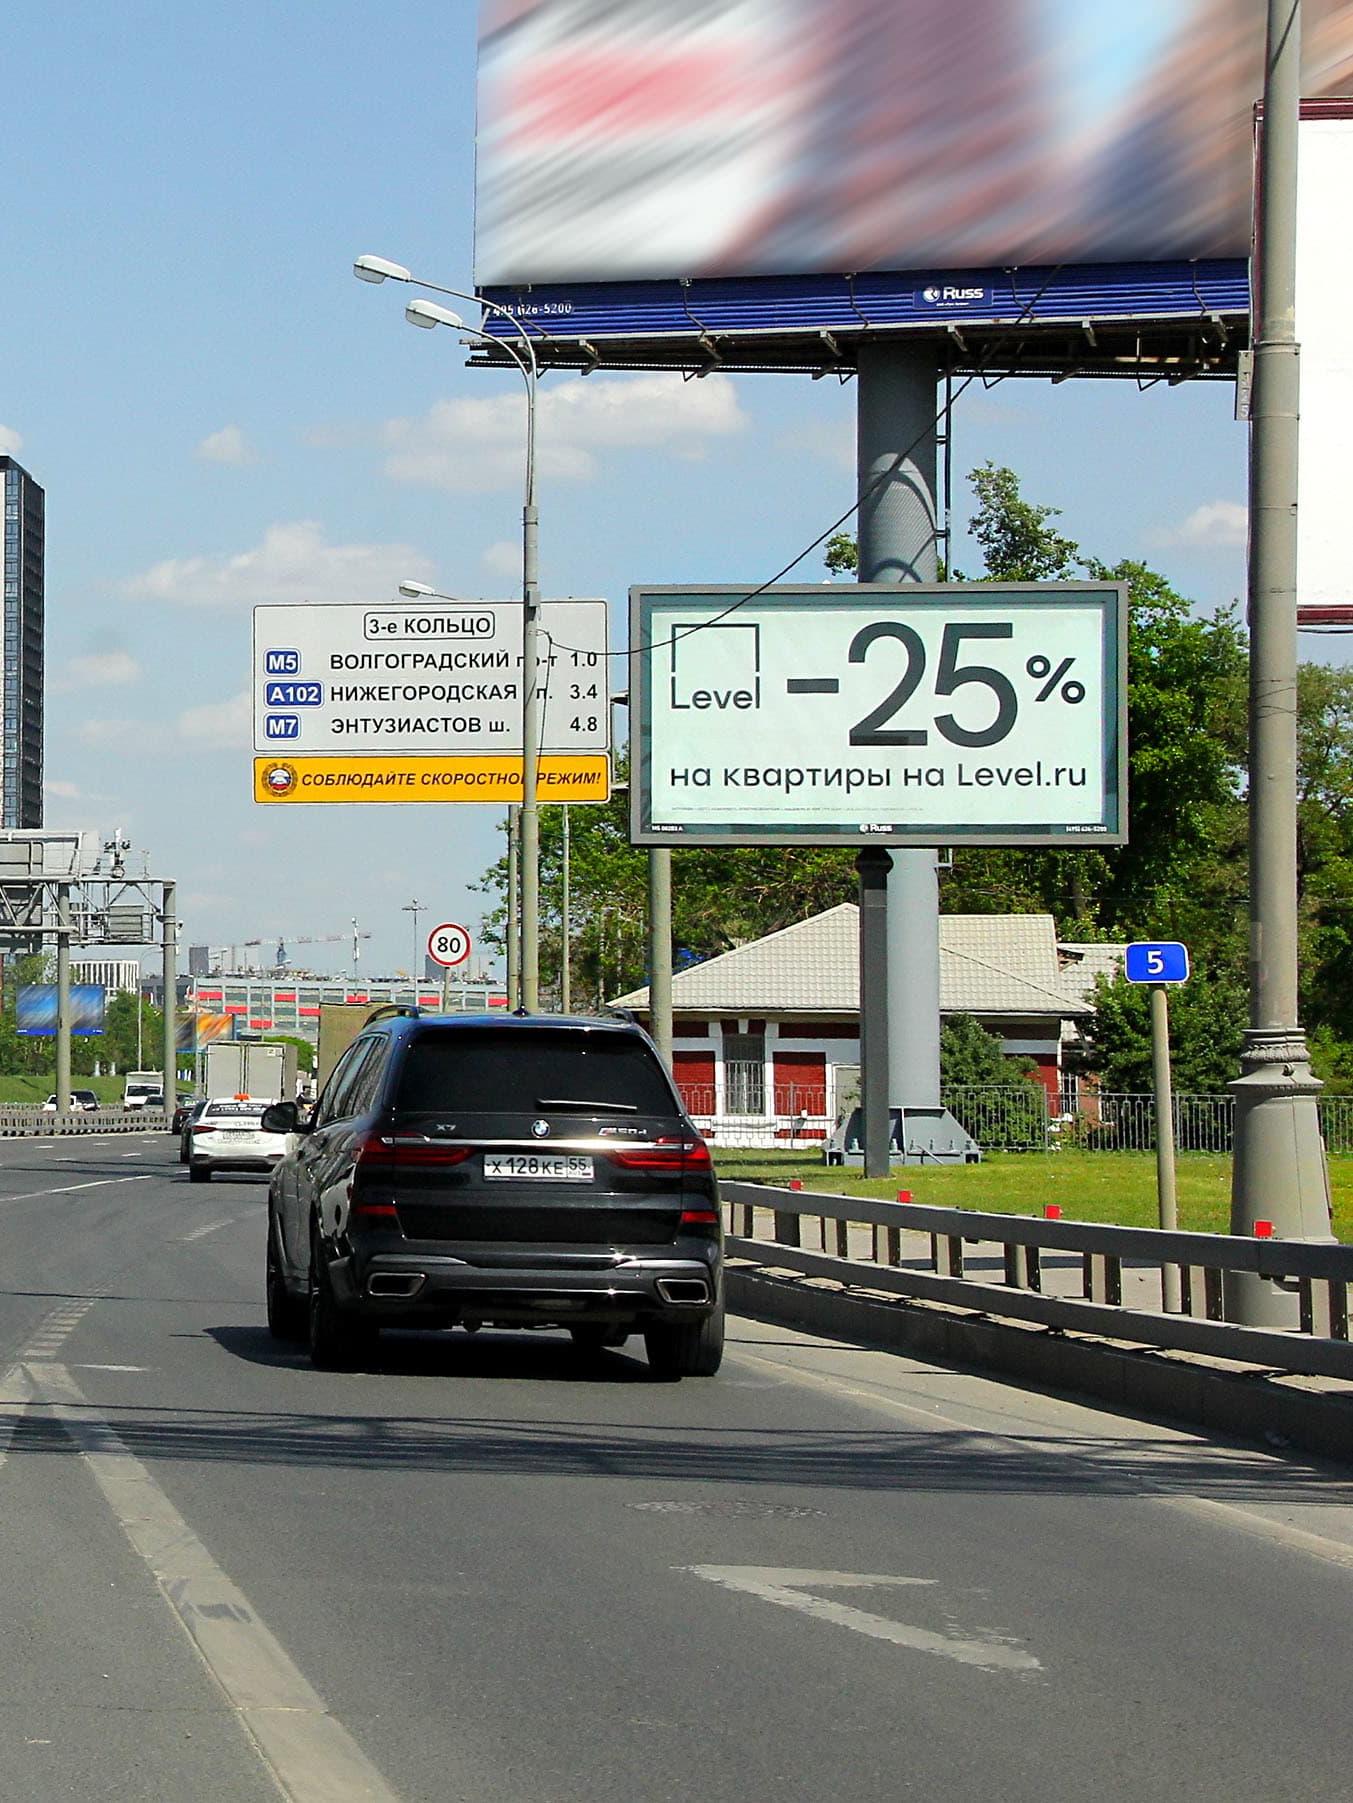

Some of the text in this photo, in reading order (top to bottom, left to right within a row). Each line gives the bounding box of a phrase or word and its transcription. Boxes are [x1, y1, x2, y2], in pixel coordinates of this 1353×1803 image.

[943, 286, 984, 299] Russ
[369, 617, 491, 636] 3-е КОЛЬЦО
[331, 649, 509, 671] ВОЛГОГРАДСКИЙ
[570, 652, 598, 667] 1.0
[331, 684, 517, 703] НИЖЕГОРОДСКАЯ
[570, 684, 598, 699] 3.4
[671, 676, 760, 709] Level
[331, 716, 598, 734] ЭНТУЗИАСТОВ ш. 4.8
[302, 770, 601, 788] СОБЛЮДАЙТЕ СКОРОСТНО РЕЖИМ!
[670, 761, 1087, 794] на квартиры на Level.ru
[437, 937, 460, 954] 80
[1147, 950, 1164, 975] 5
[436, 1124, 457, 1132] X7
